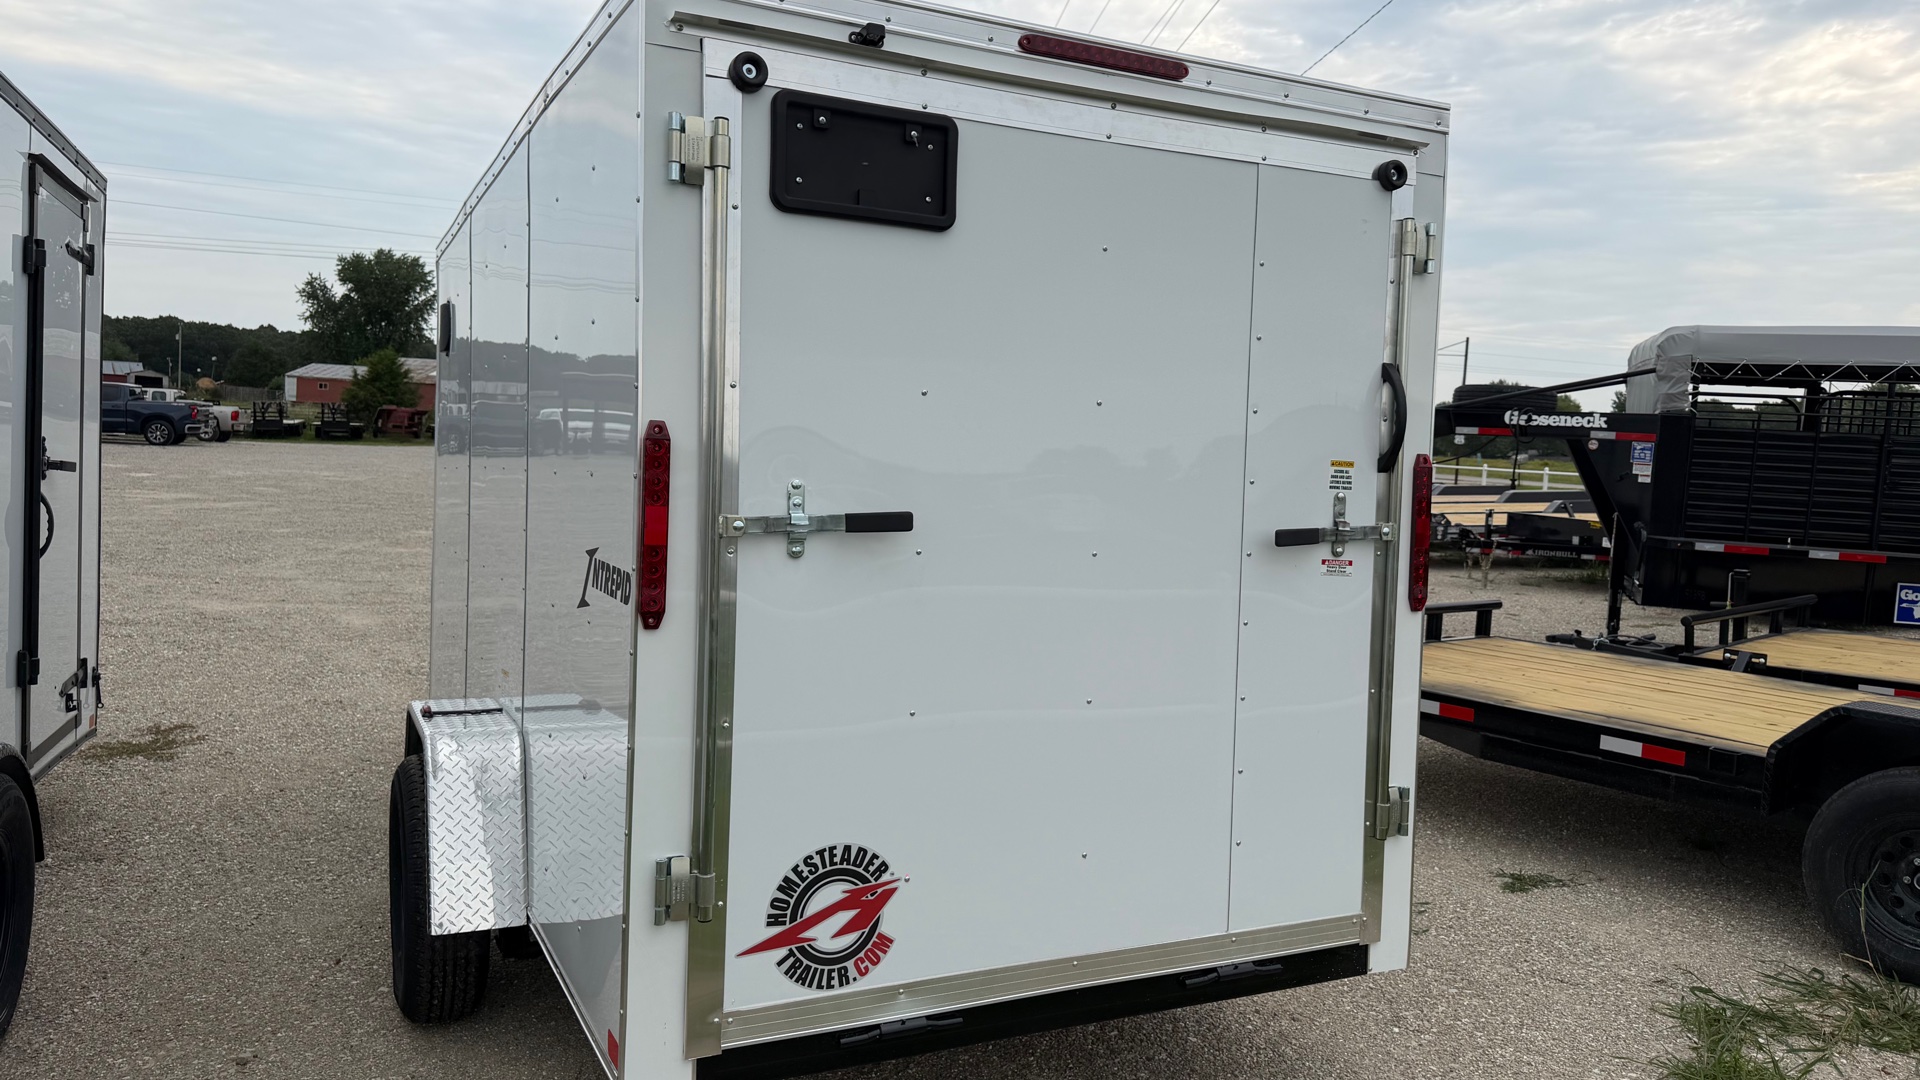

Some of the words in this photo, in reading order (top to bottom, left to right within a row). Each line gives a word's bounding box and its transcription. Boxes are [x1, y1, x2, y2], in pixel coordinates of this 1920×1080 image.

[1504, 410, 1608, 429] Gooseneck
[1534, 549, 1578, 558] IRONBULL
[577, 547, 631, 608] INTREPID
[766, 845, 889, 927] HOMESTEADER
